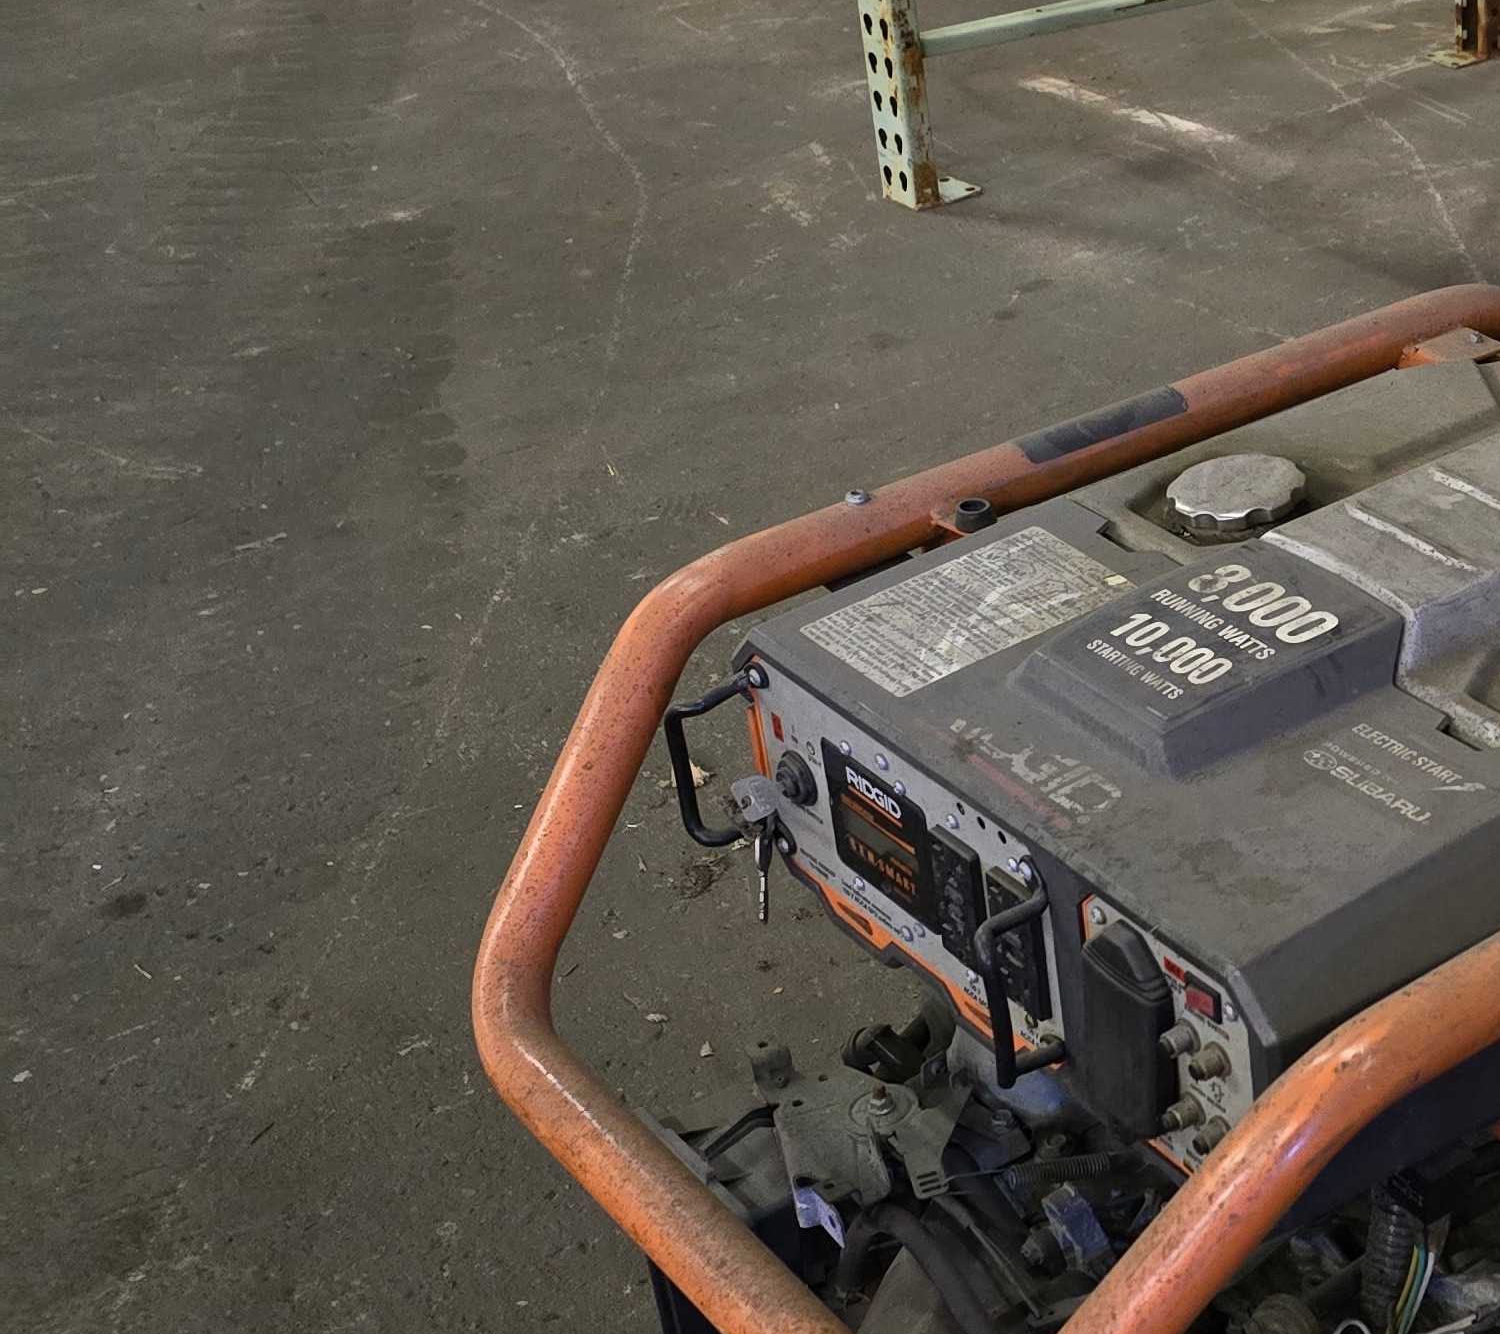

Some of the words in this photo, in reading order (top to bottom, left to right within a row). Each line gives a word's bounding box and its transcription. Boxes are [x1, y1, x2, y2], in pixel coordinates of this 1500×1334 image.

[1150, 589, 1224, 630] RUNNING
[1218, 625, 1276, 660] WATTS
[1188, 564, 1339, 643] 8,000
[1086, 639, 1145, 676] STARTING
[1140, 670, 1184, 699] WATTS
[1110, 613, 1233, 685] 10,000
[845, 766, 902, 819] RIDGID
[1330, 765, 1432, 822] SUBARU
